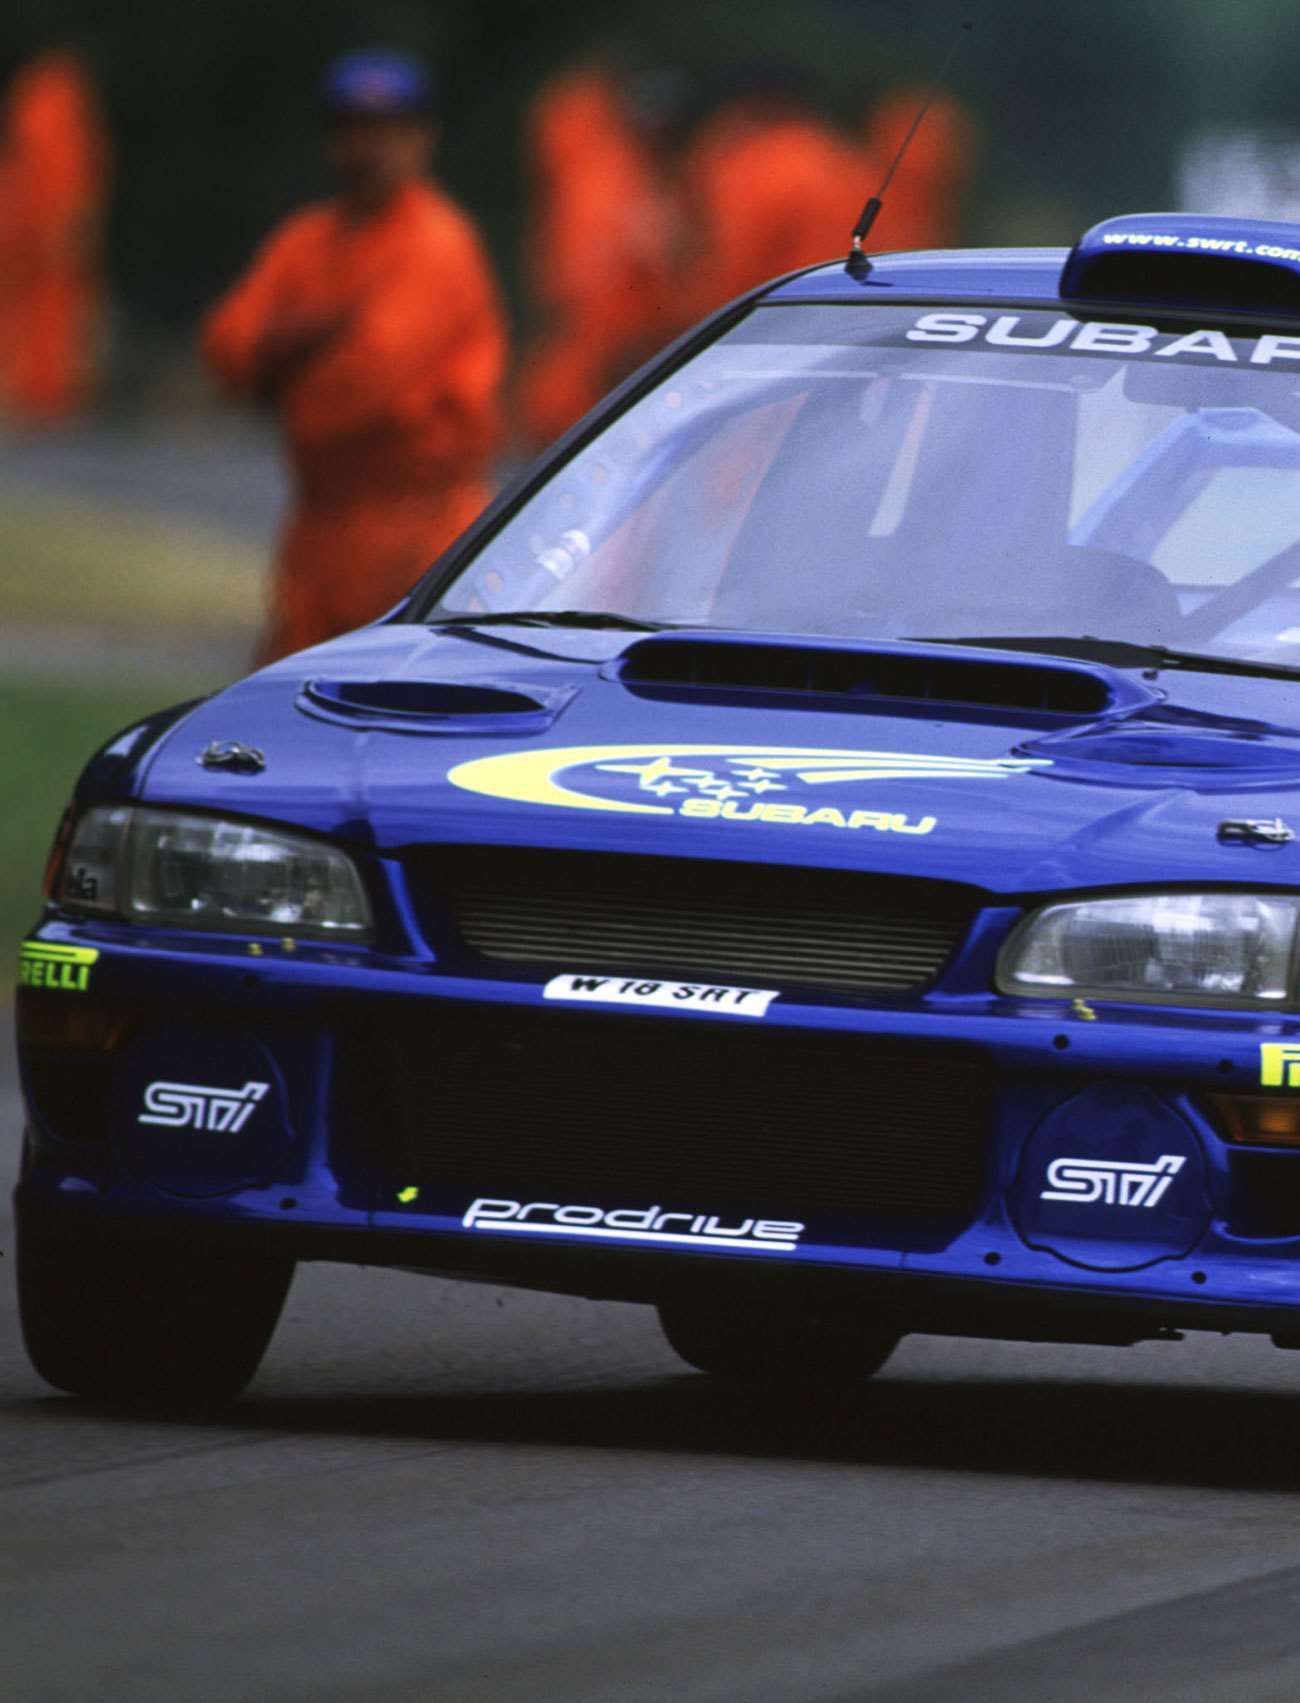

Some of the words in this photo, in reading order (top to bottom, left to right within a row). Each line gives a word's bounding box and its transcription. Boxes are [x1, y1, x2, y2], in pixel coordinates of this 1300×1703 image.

[680, 798, 937, 834] SUBARU
[570, 978, 610, 992] W
[462, 1197, 806, 1244] prodrive
